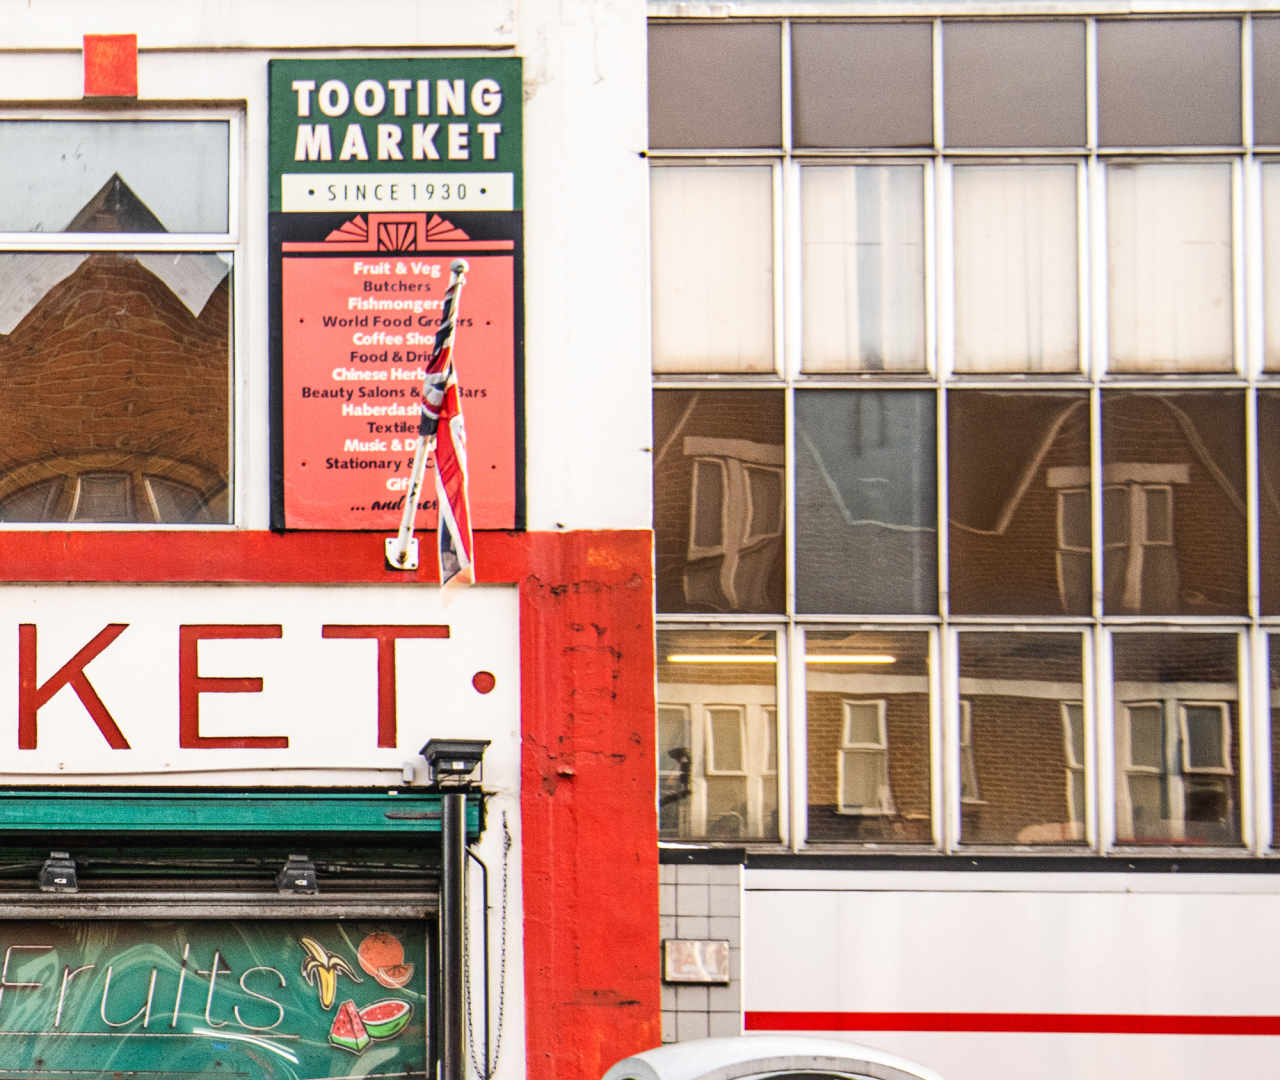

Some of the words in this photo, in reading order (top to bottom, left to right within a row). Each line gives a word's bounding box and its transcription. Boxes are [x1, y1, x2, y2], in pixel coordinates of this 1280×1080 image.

[292, 79, 502, 117] TOOTING
[294, 122, 501, 161] MARKET
[328, 183, 400, 201] SINCE
[411, 183, 467, 200] 1930
[353, 261, 390, 275] Fruit
[396, 262, 406, 275] &
[411, 262, 441, 278] Veg
[363, 280, 431, 293] Butchers
[323, 315, 369, 327] World
[373, 315, 414, 327] Food
[353, 332, 403, 345] Coffee
[350, 351, 388, 363] Food
[392, 351, 403, 363] &
[332, 367, 387, 381] Chinese
[301, 387, 354, 400] Beauty
[358, 387, 405, 399] Salons
[409, 387, 420, 398] &
[344, 438, 388, 452] Music
[391, 438, 403, 452] &
[325, 457, 402, 471] Stationary
